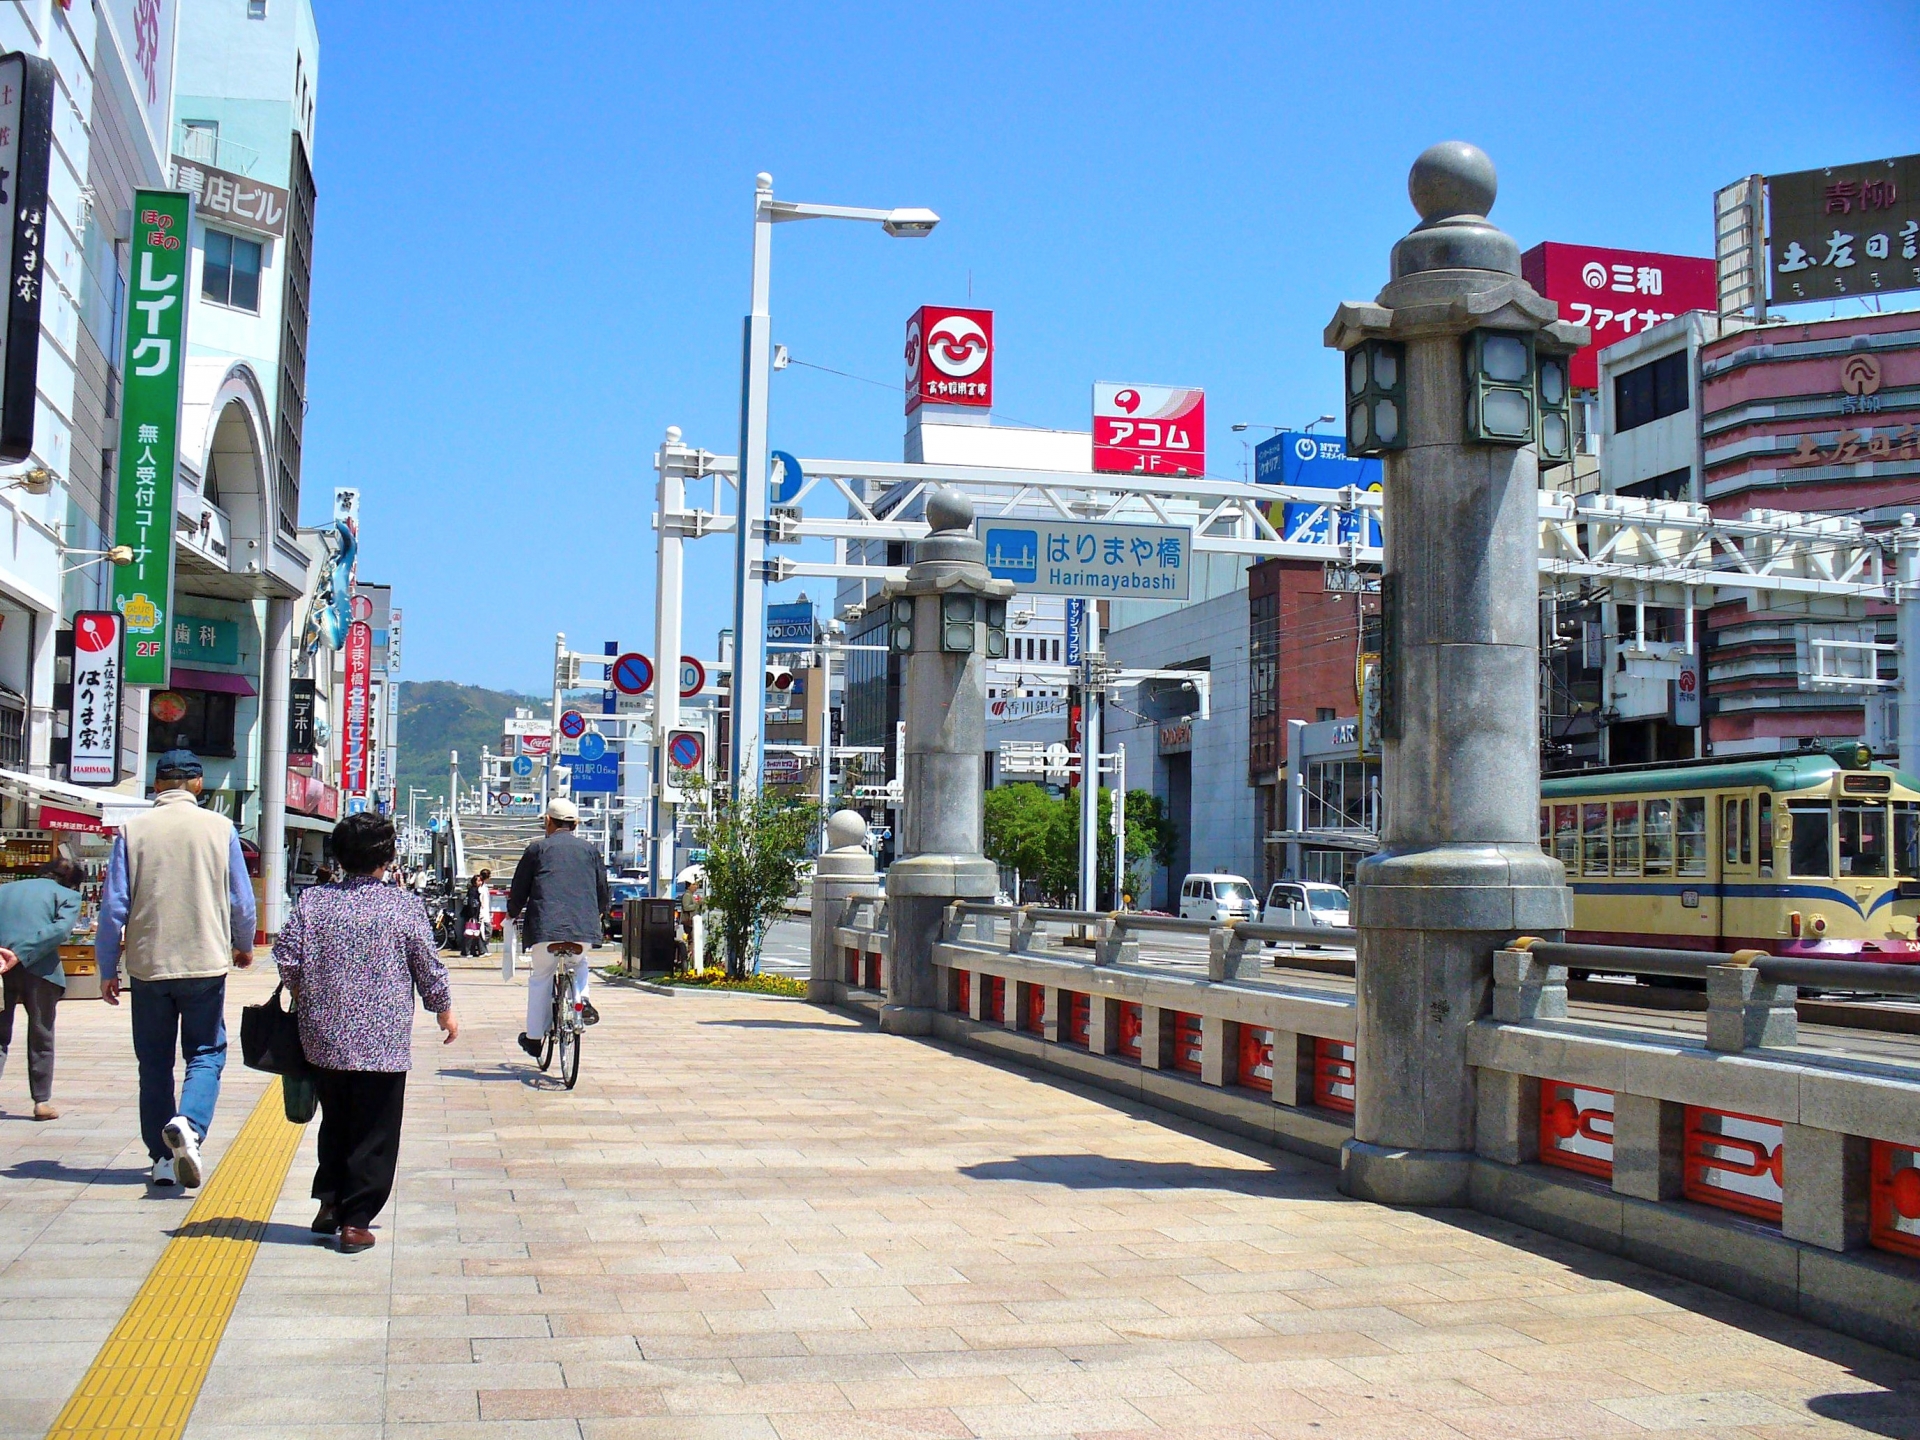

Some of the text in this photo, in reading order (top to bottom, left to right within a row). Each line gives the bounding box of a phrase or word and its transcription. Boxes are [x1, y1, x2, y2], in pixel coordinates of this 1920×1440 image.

[1825, 180, 1896, 214] 青柳
[1611, 264, 1662, 295] 三和
[132, 251, 179, 377] レイク
[927, 380, 988, 397] 高知信用金庫
[1841, 395, 1881, 414] 青柳
[1109, 420, 1190, 449] アコム
[1320, 443, 1341, 453] NTT
[1137, 454, 1161, 470] 1F
[133, 424, 159, 581] 無人受付コーナー
[1047, 533, 1181, 568] はりまや橋
[1050, 568, 1175, 591] Harimayabashi
[174, 622, 216, 647] 歯科
[1070, 598, 1081, 663] ャッシュプラザ
[136, 641, 160, 656] 2F
[78, 670, 101, 750] はりま家
[101, 657, 115, 750] 土佐みやげ専門店
[345, 625, 367, 788] はりまや橋名産センター
[1009, 701, 1061, 715] 香川銀行
[73, 765, 111, 774] HARIMAYA
